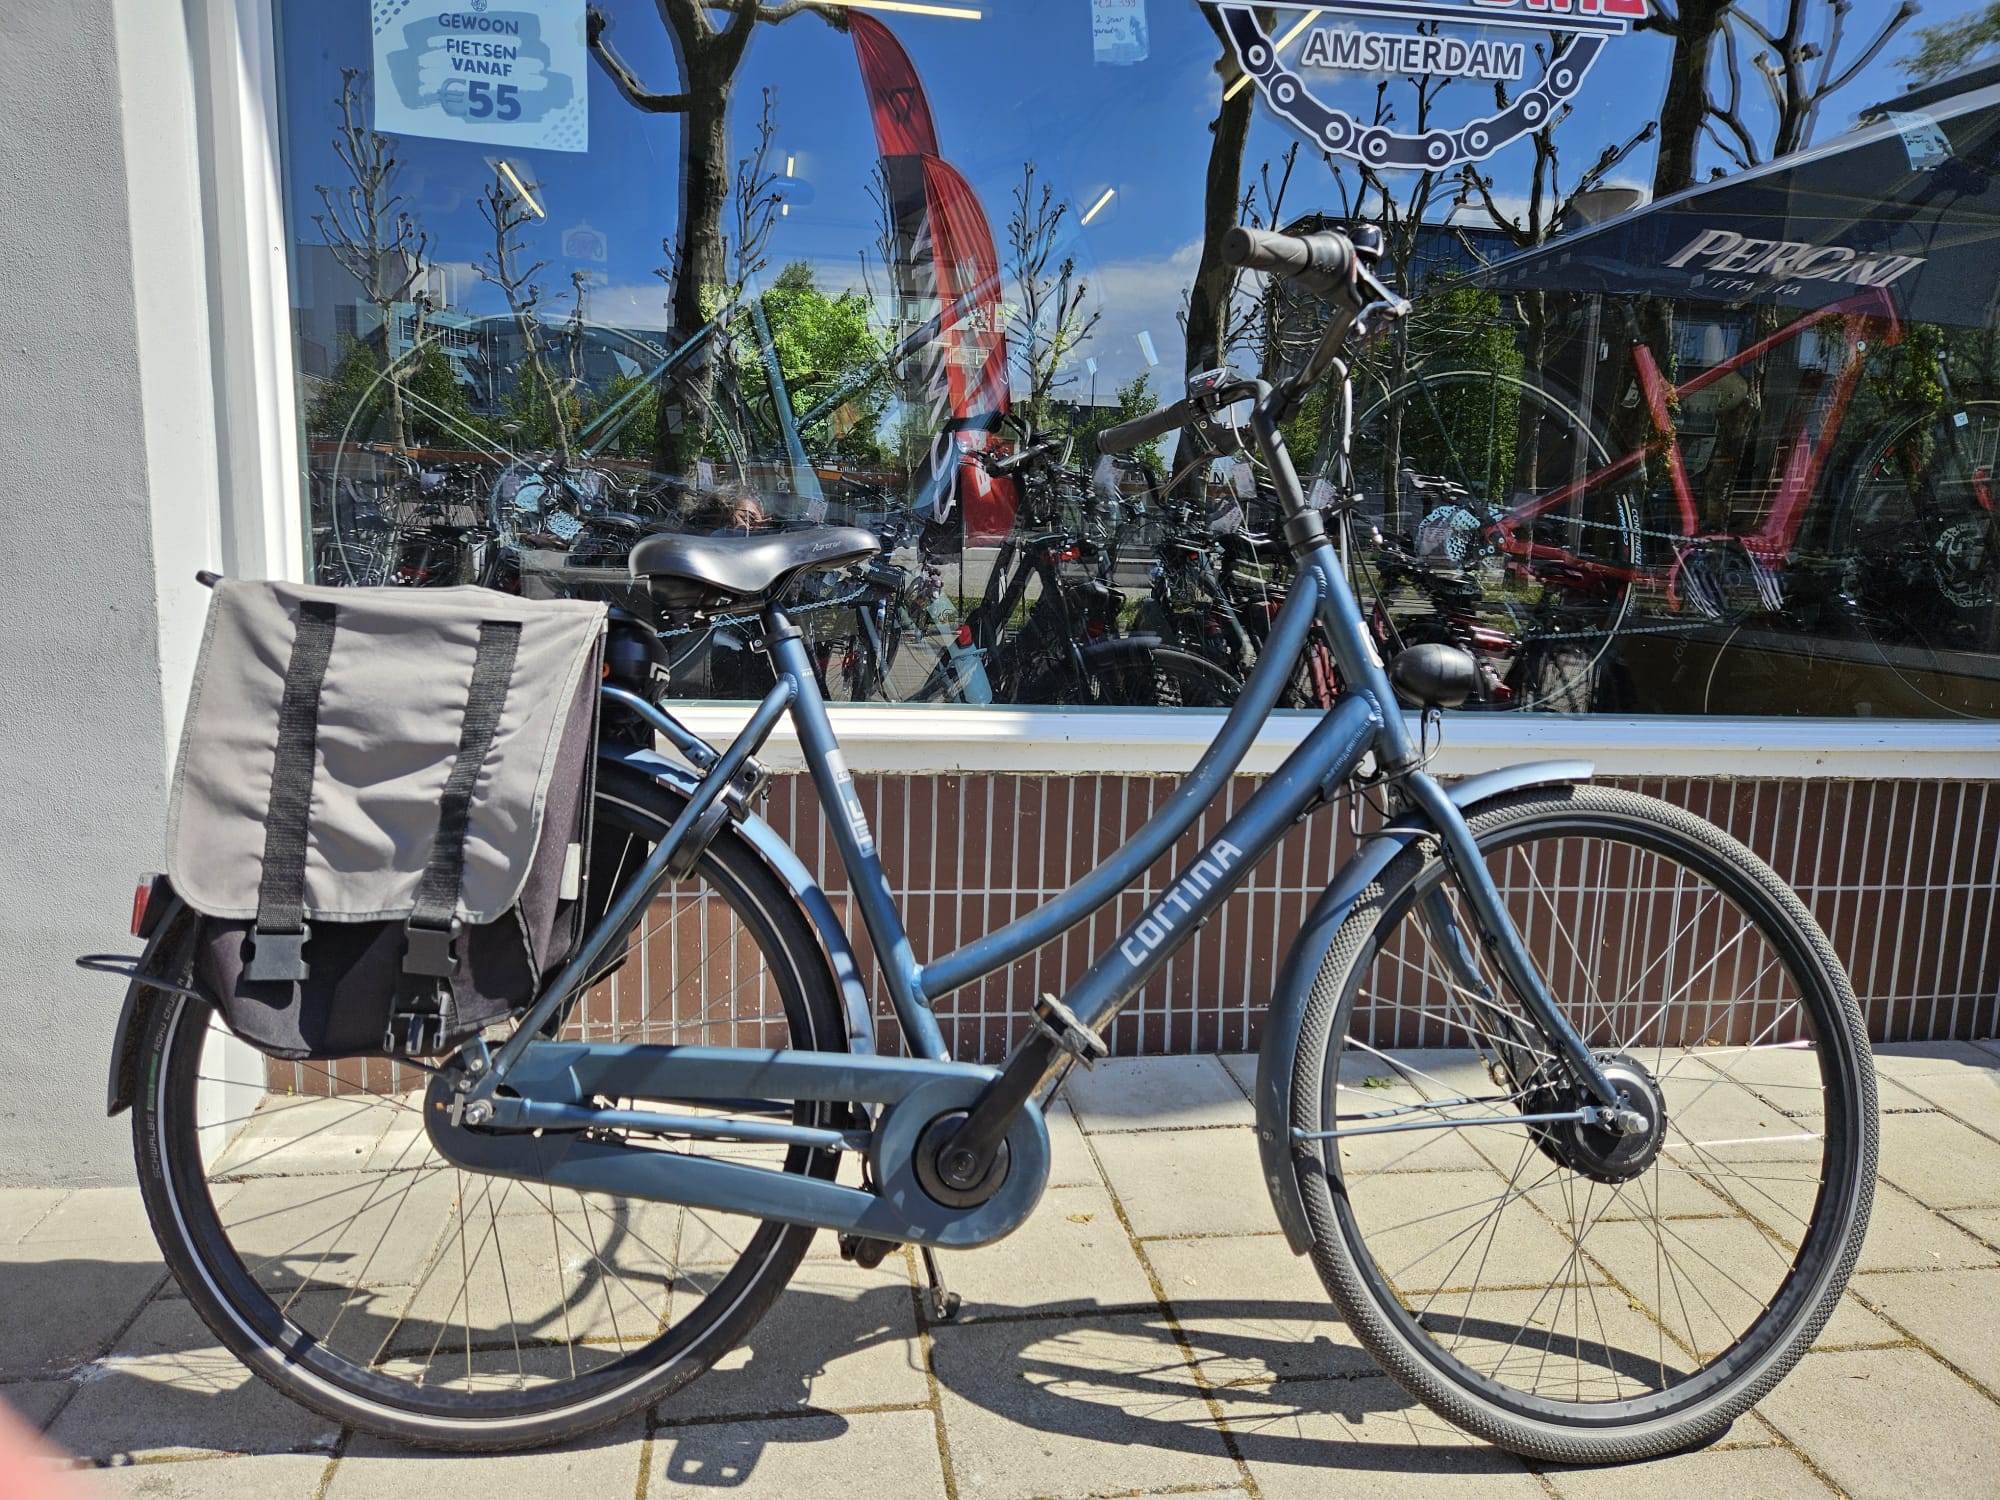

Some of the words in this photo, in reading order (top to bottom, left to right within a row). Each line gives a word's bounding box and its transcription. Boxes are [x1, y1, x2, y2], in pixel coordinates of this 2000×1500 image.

[438, 12, 519, 35] GEWOON
[446, 38, 517, 61] FIETSEN
[452, 57, 512, 77] VANAF
[1304, 30, 1523, 77] AMSTERDAM
[1120, 839, 1243, 967] CORTINA
[147, 1112, 162, 1179] SCHWALBE
[163, 977, 185, 1020] CRUISR
